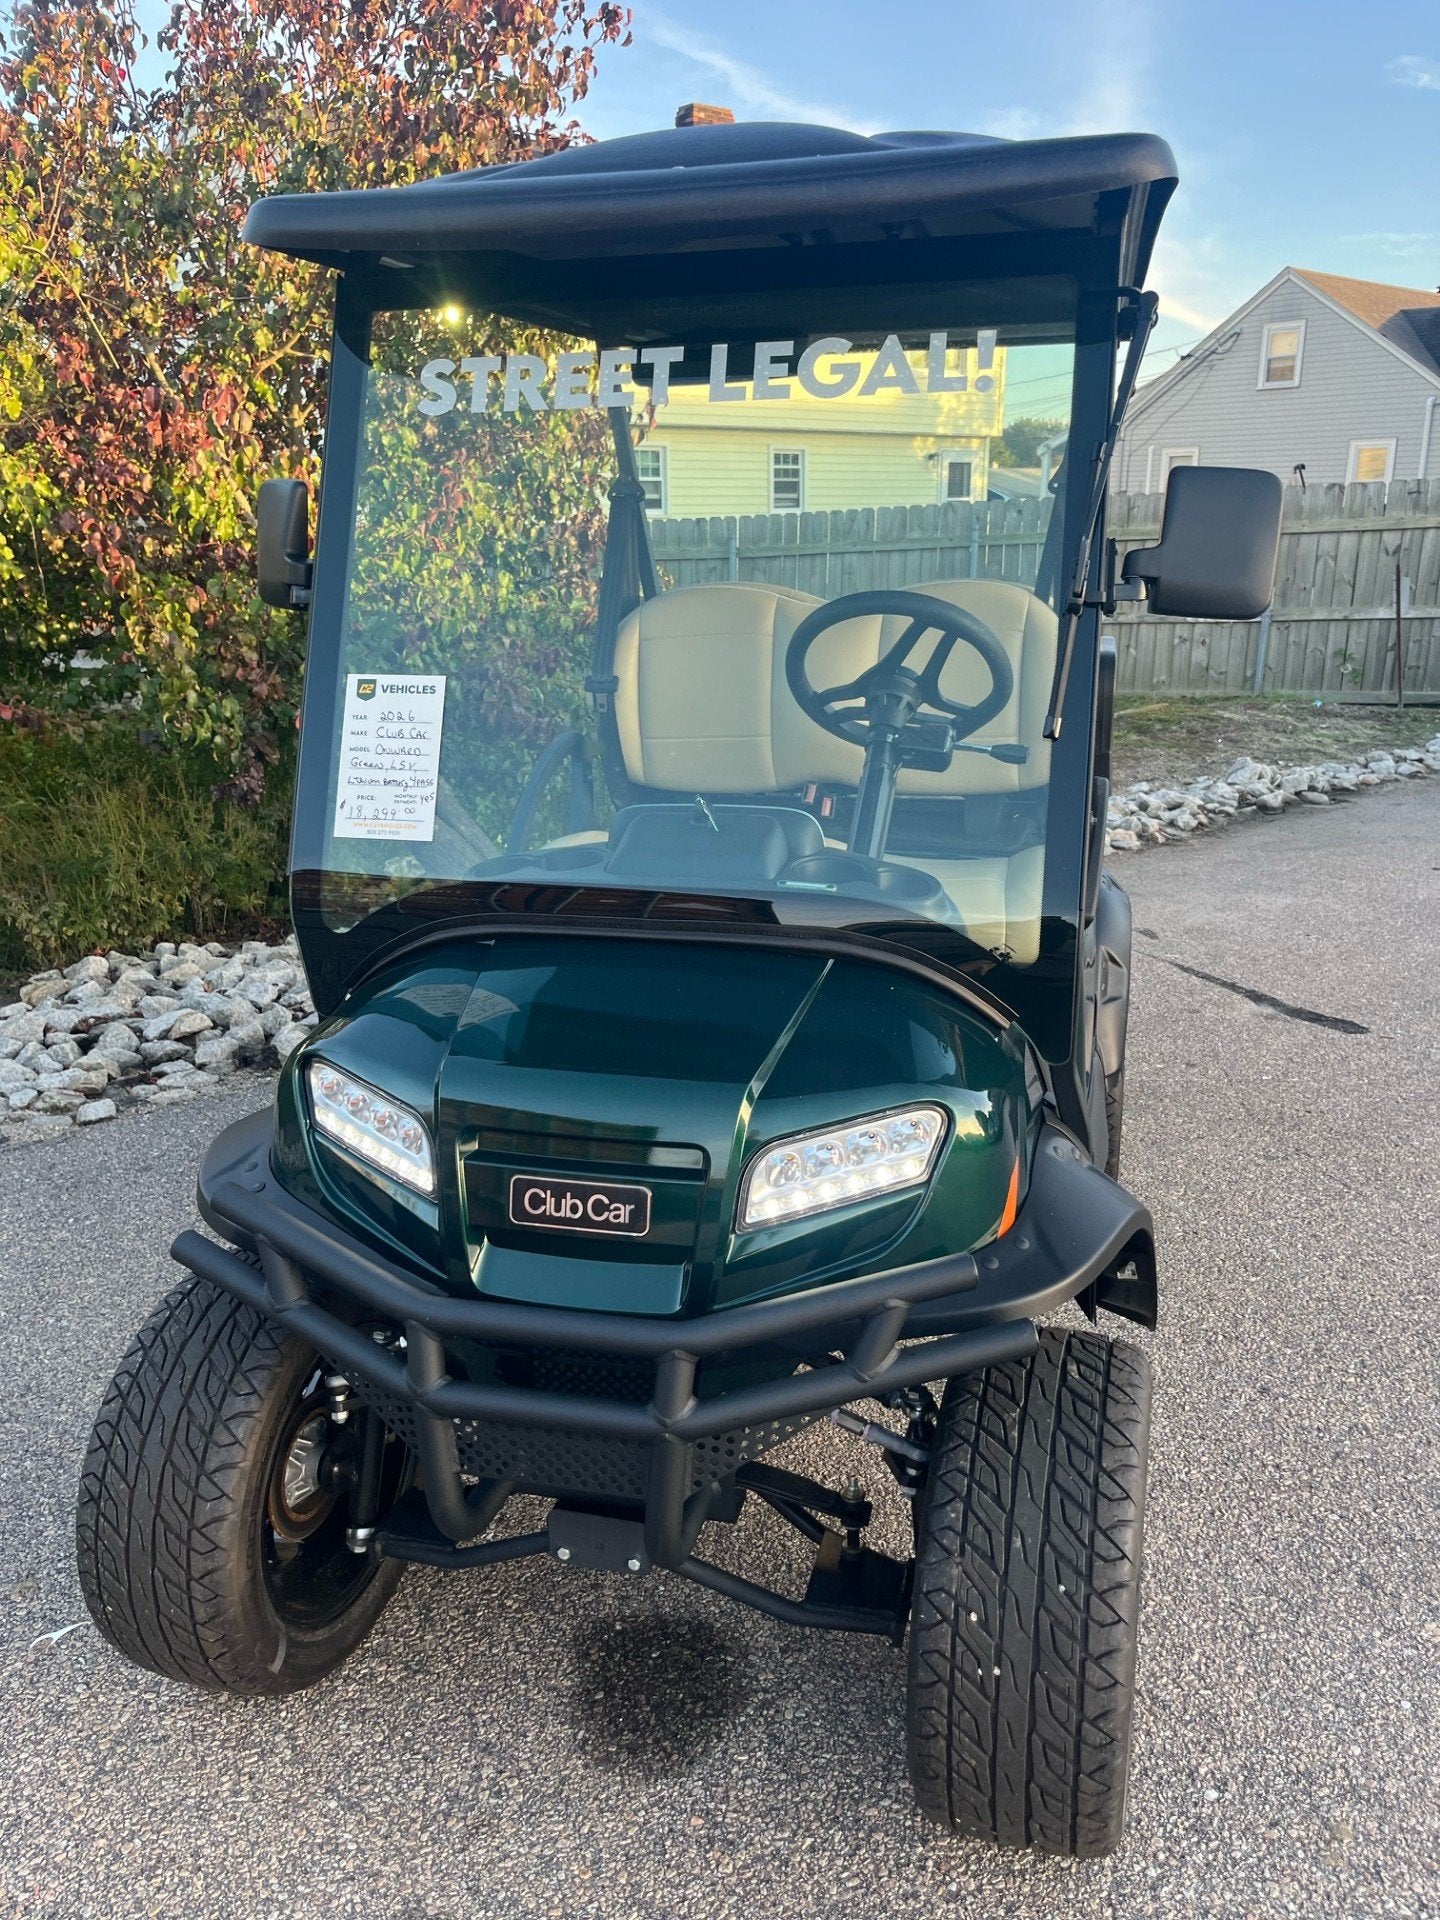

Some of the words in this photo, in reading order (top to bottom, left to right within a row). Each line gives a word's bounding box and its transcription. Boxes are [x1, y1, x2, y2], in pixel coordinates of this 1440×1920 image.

[417, 345, 685, 416] STREET
[708, 329, 998, 402] LEGAL!
[381, 684, 437, 695] VEHICLES
[380, 710, 415, 722] 2026
[523, 1187, 584, 1219] Club
[587, 1193, 635, 1224] Car
